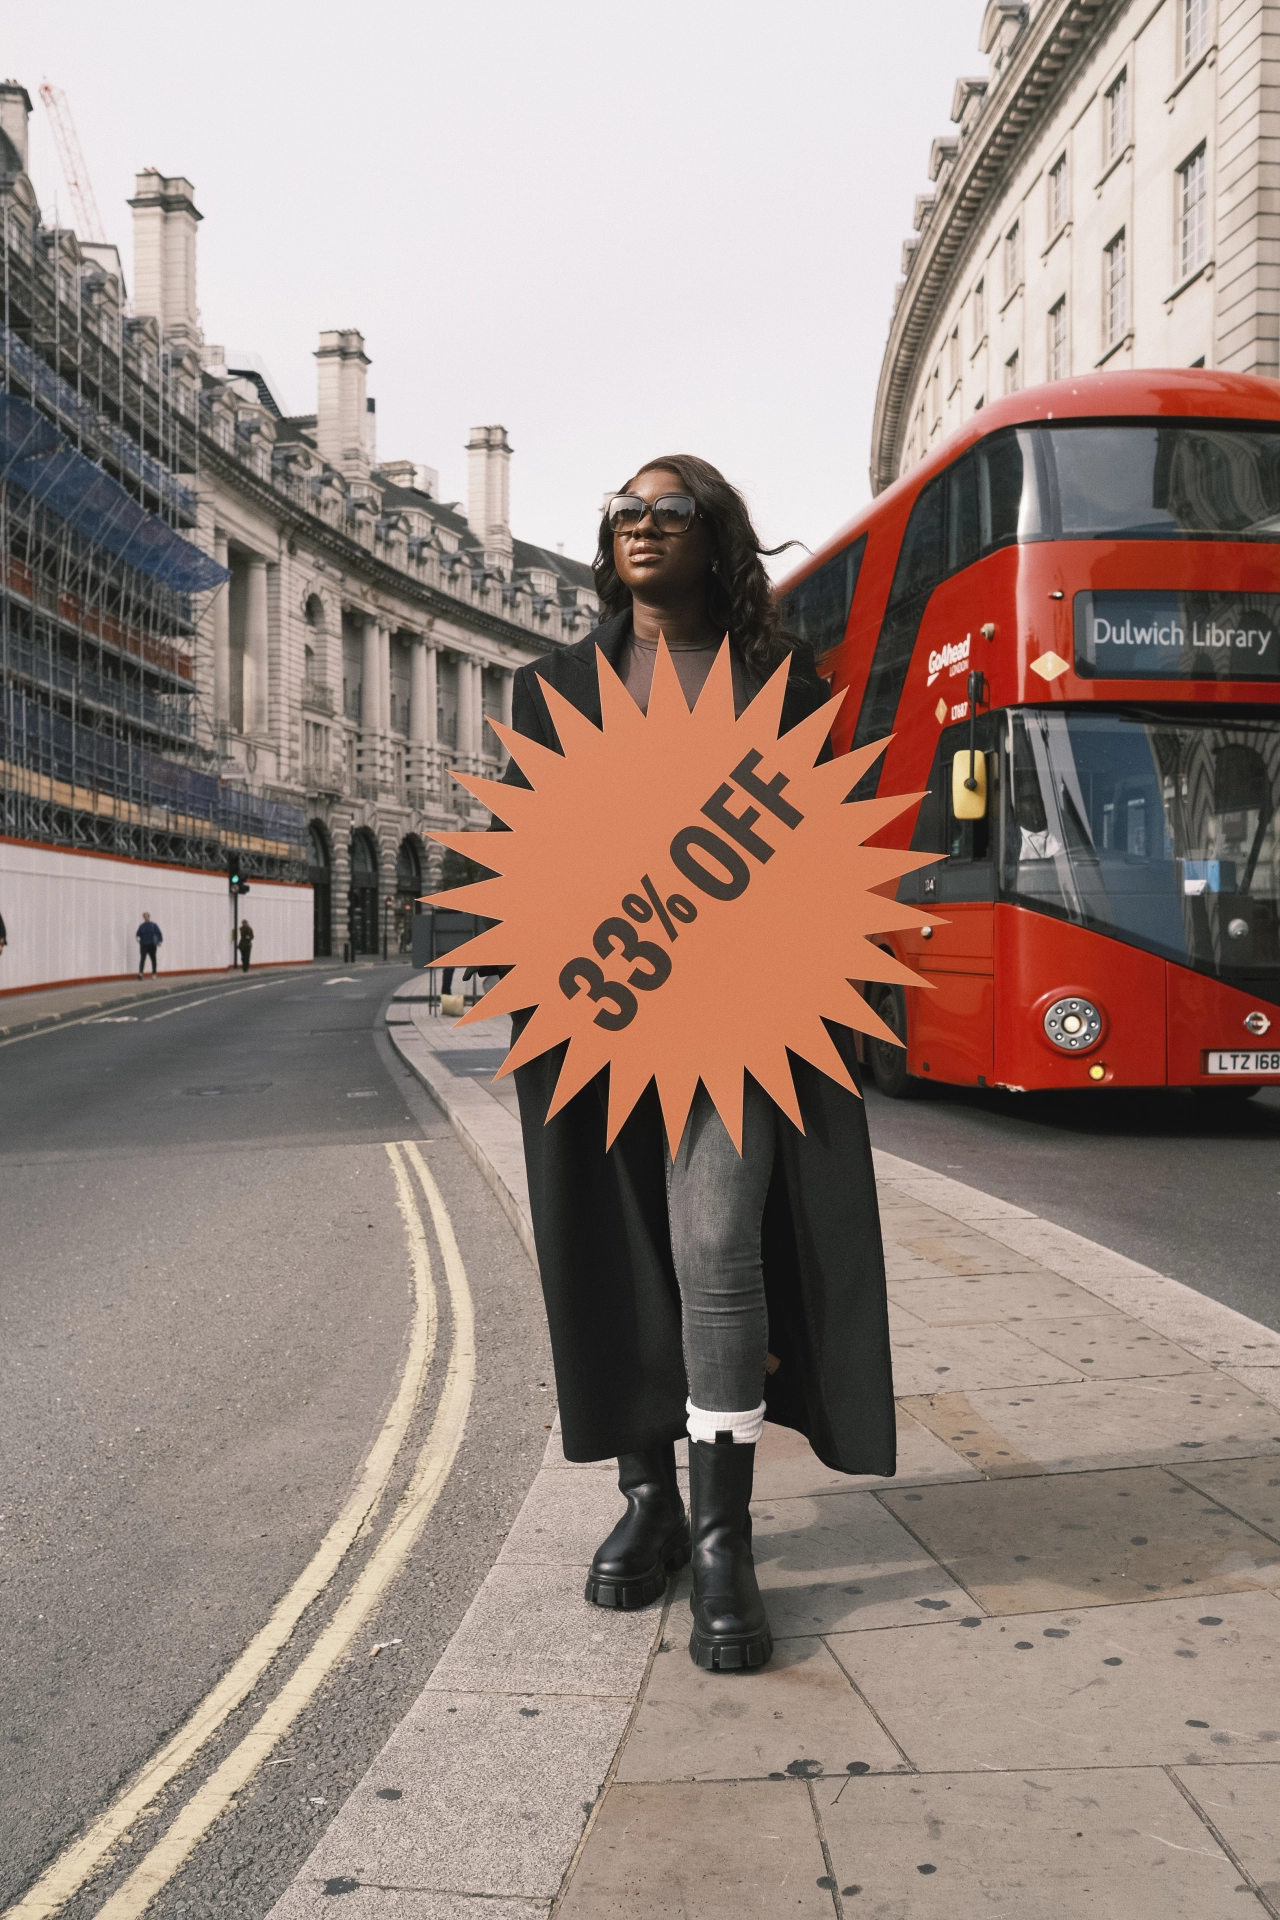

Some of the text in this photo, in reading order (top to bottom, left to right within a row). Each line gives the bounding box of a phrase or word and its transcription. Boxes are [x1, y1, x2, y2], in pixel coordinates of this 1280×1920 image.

[1094, 618, 1271, 655] Dulwich Library
[949, 659, 969, 677] LONDON
